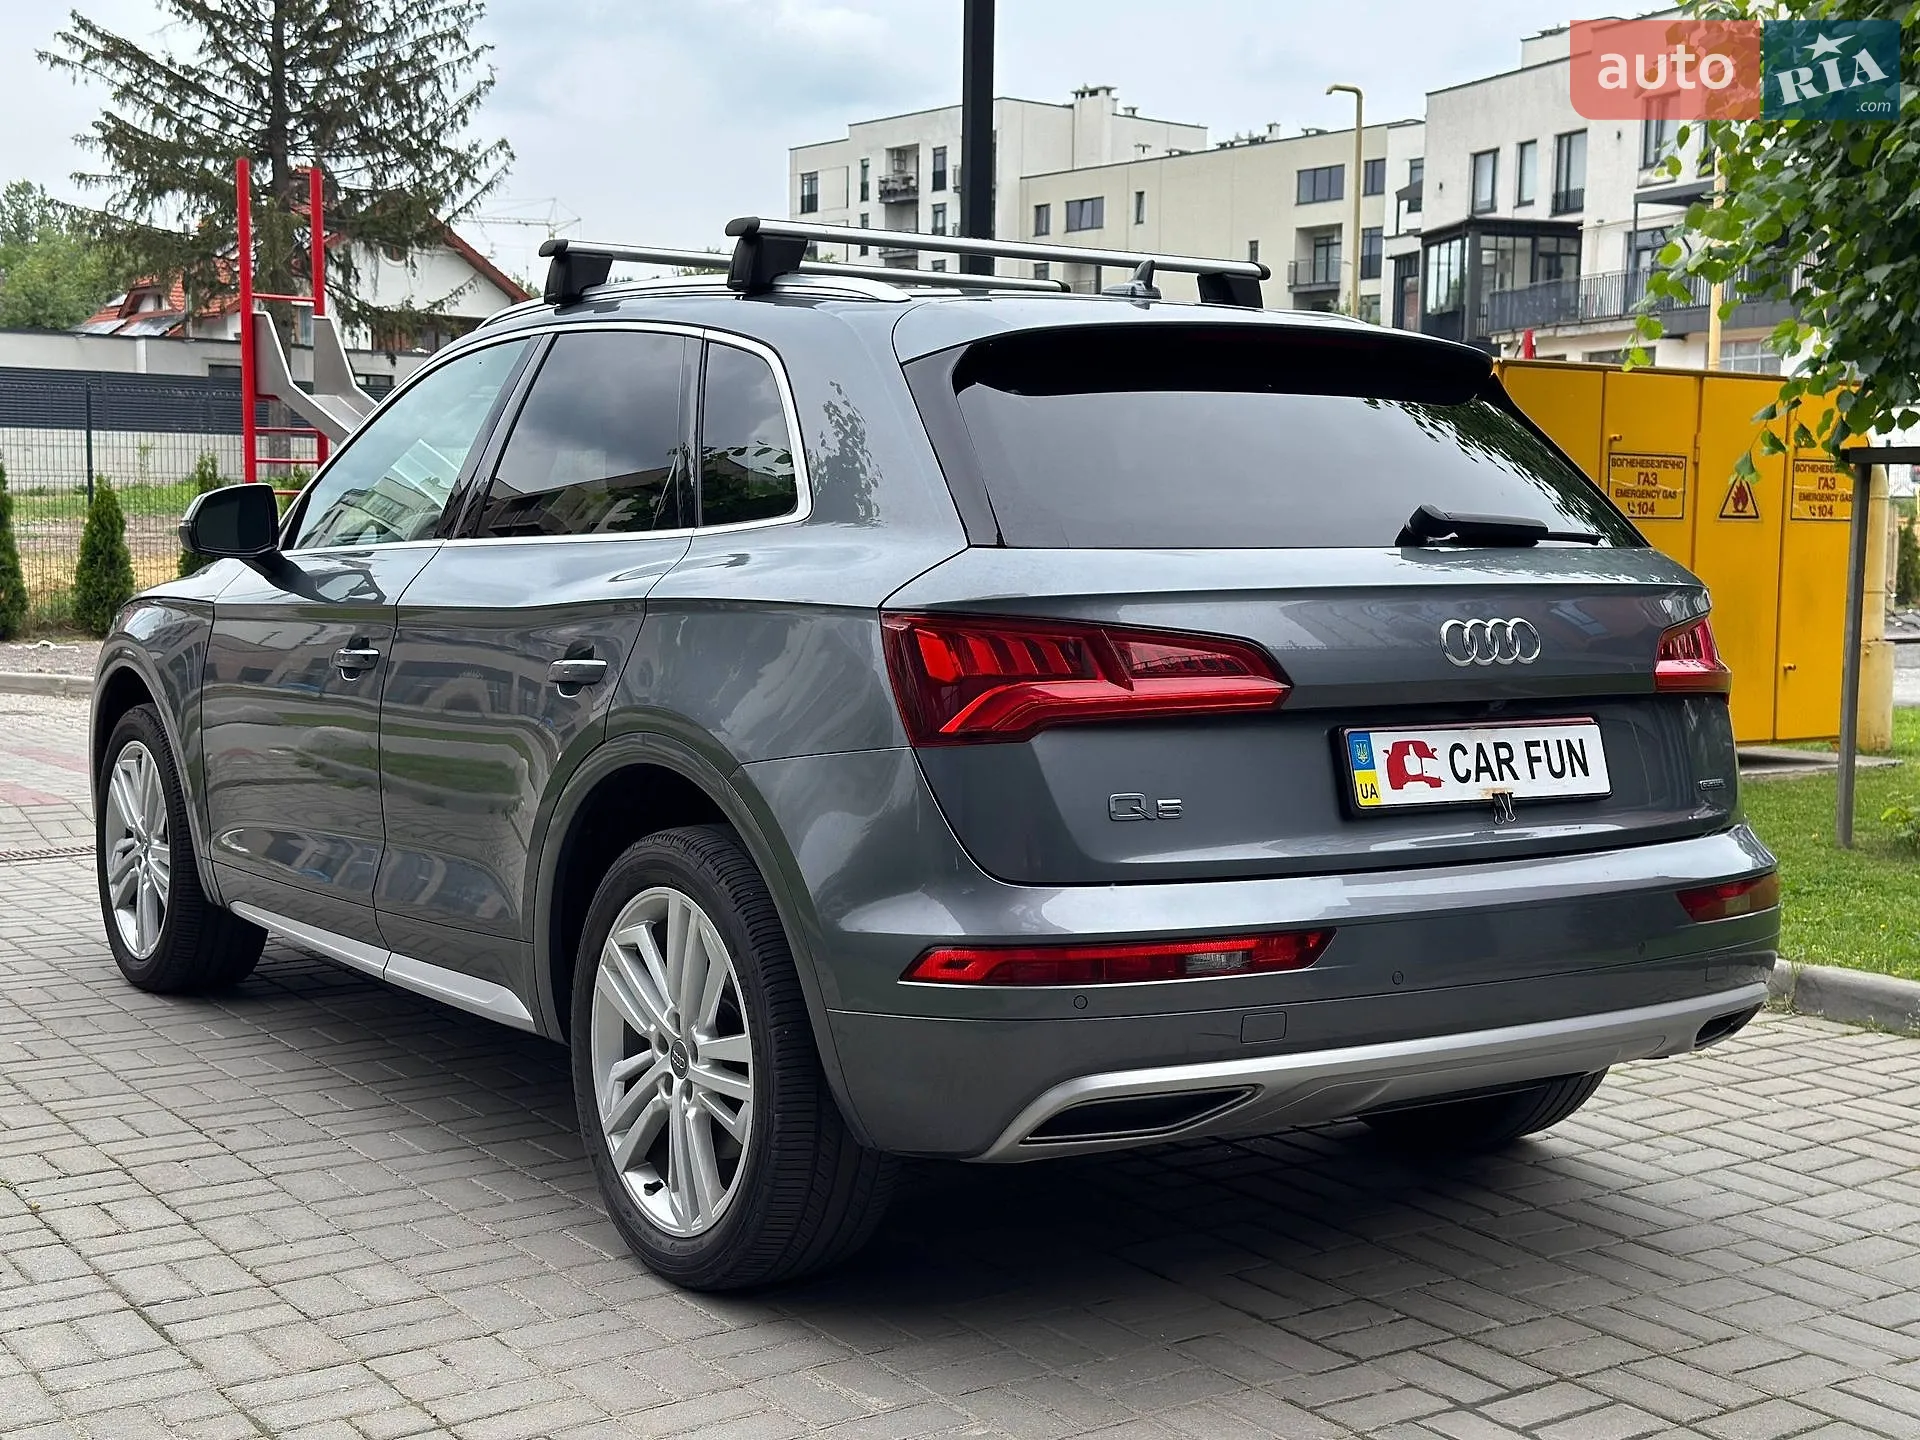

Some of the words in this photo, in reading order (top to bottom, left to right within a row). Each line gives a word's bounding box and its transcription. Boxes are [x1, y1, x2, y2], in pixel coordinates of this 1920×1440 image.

[1611, 457, 1684, 469] ВОГНЕНЕБЕЗПЕЧНО
[1637, 471, 1658, 486] ГАЗ
[1817, 476, 1836, 490] ГАЗ
[1615, 488, 1661, 498] EMERGENCY
[1662, 490, 1678, 499] GAS
[1798, 492, 1838, 502] EMERGENCY
[1637, 501, 1656, 515] 104
[1818, 504, 1834, 517] 104
[1448, 741, 1521, 784] CAR
[1524, 738, 1590, 780] FUN
[1360, 782, 1379, 800] UA
